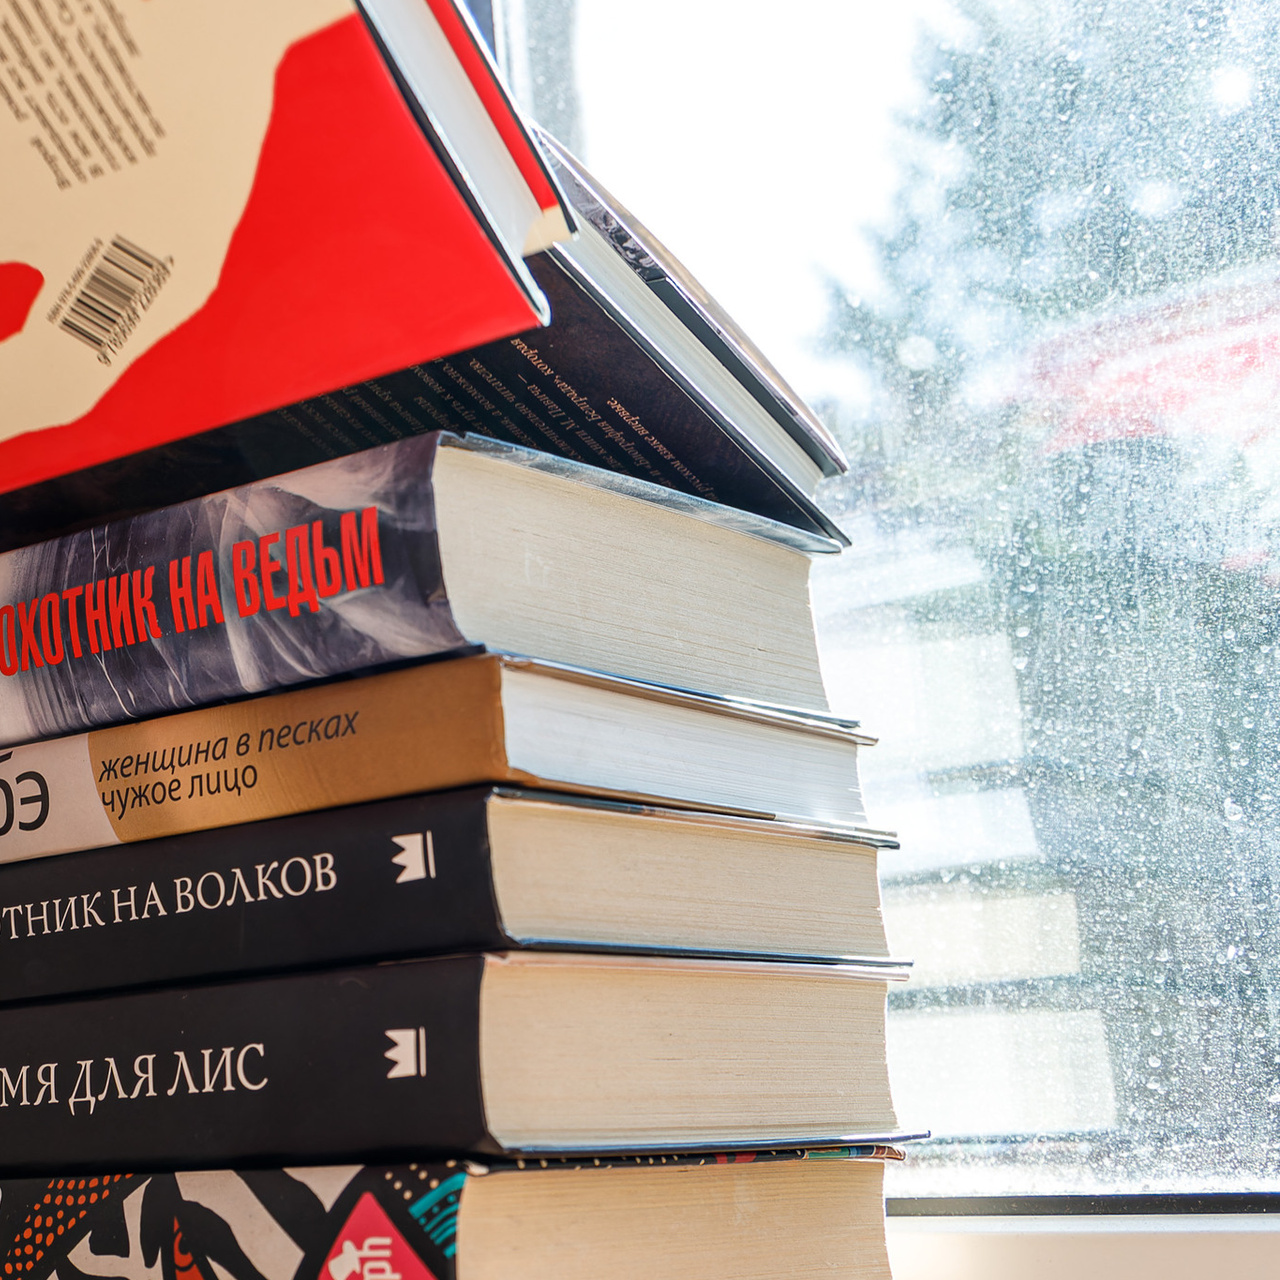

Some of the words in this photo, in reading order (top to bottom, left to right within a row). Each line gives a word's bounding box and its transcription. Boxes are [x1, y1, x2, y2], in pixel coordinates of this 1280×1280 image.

[168, 554, 225, 634] НА
[232, 506, 386, 618] ВЕДЬМ
[98, 734, 229, 783] женщина
[235, 732, 254, 758] в
[258, 708, 360, 752] песках
[100, 774, 183, 821] чужое
[187, 764, 258, 804] лицо
[111, 885, 168, 923] НА
[174, 852, 339, 916] ВОЛКОВ
[67, 1054, 157, 1116] ДЛЯ
[166, 1043, 268, 1096] ЛИС
